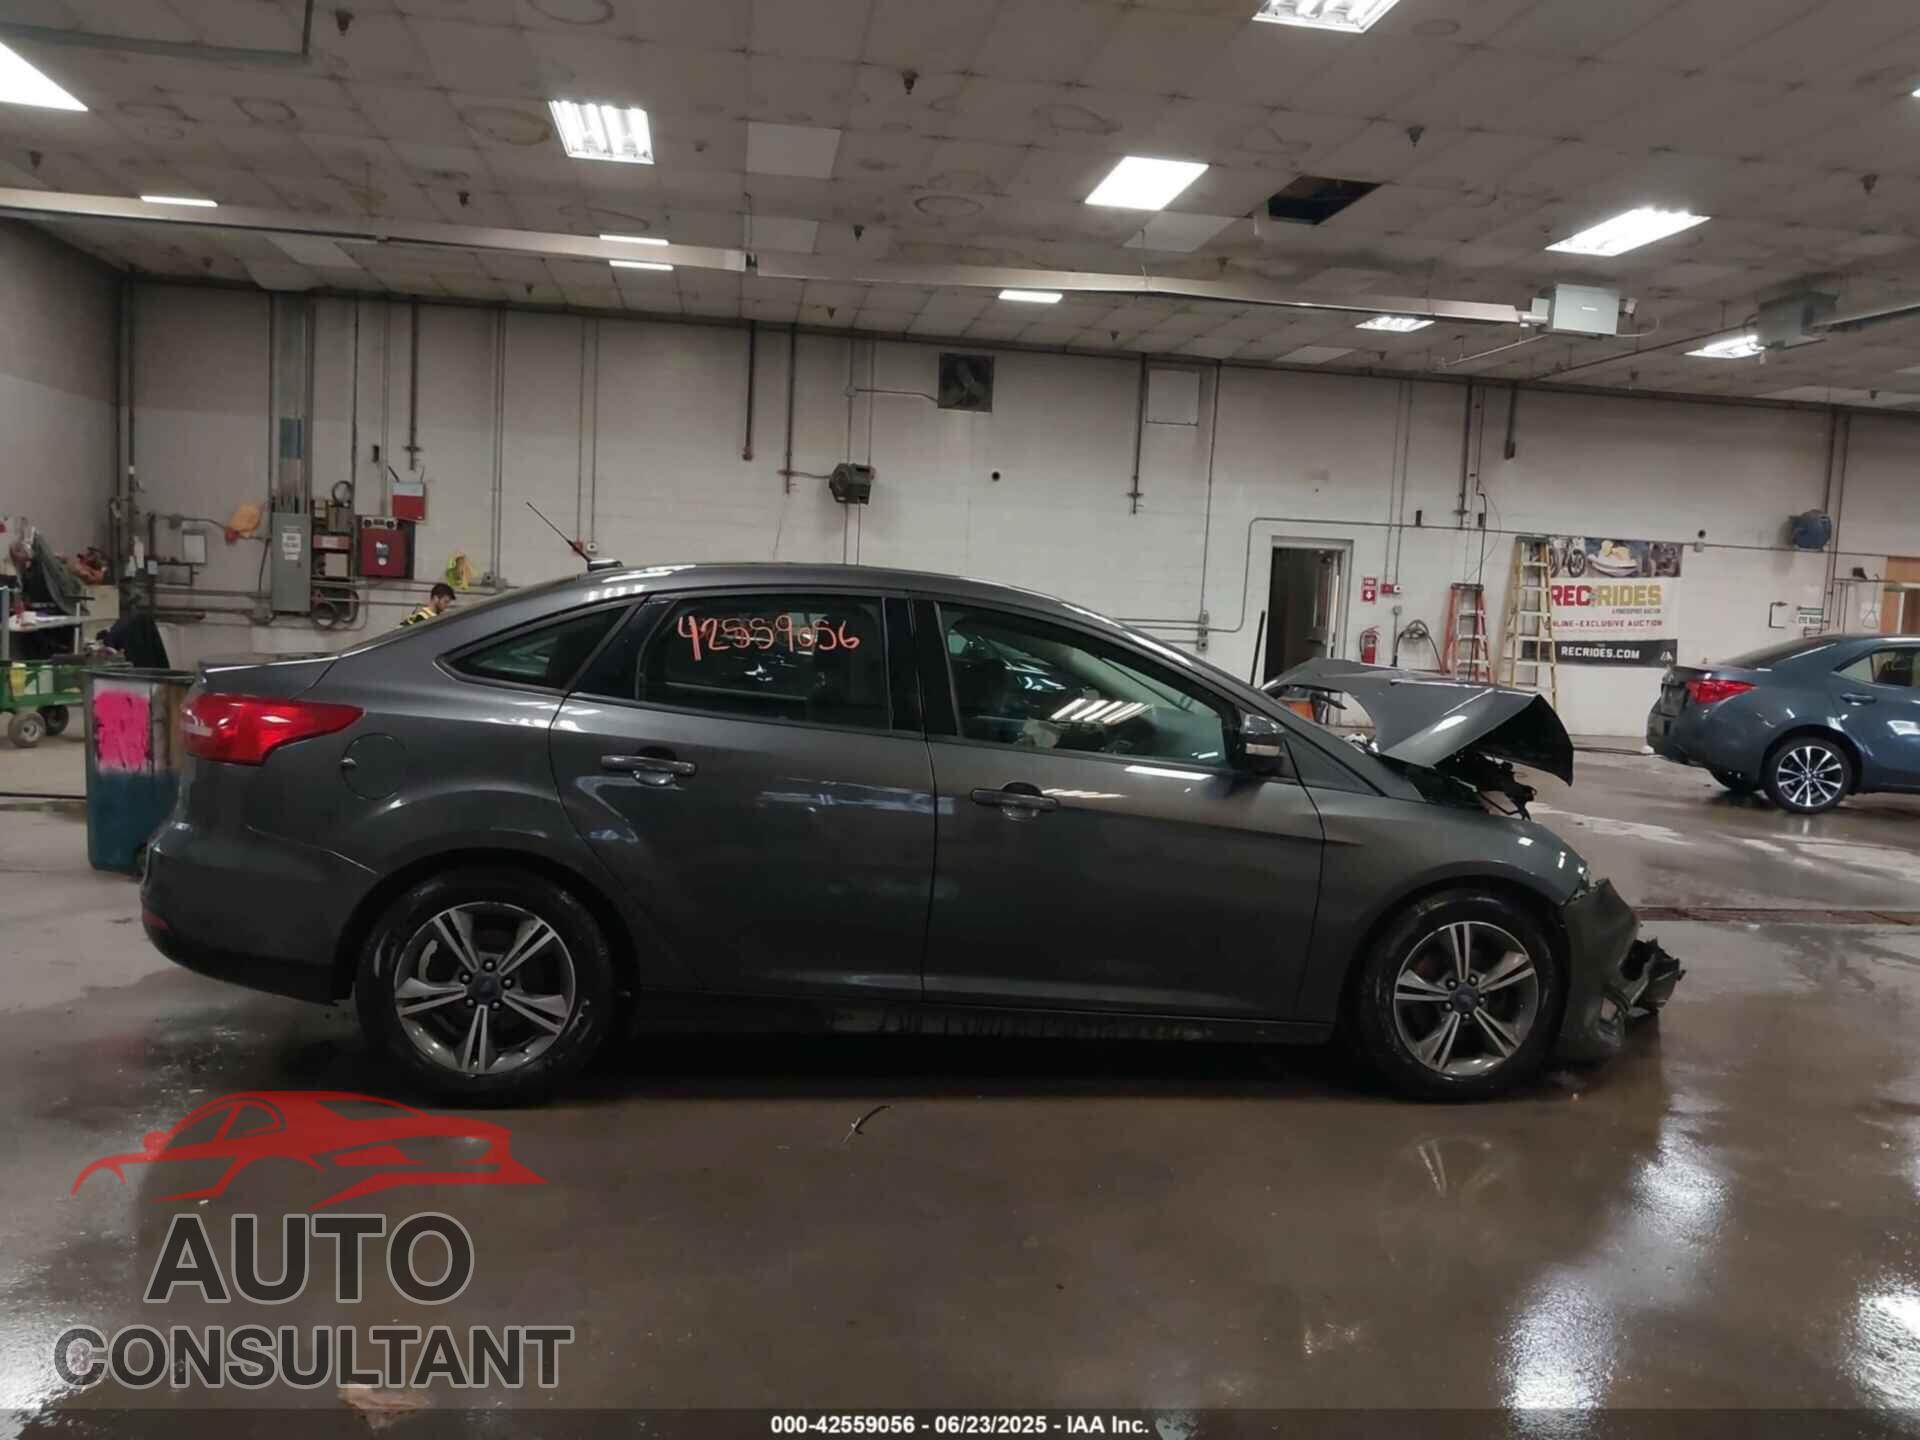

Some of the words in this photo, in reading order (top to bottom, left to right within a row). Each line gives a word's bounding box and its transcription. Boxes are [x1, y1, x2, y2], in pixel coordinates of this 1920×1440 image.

[1627, 619, 1662, 627] AUCTION
[677, 614, 860, 661] 42559056
[1560, 646, 1641, 659] RECRIDES.COM
